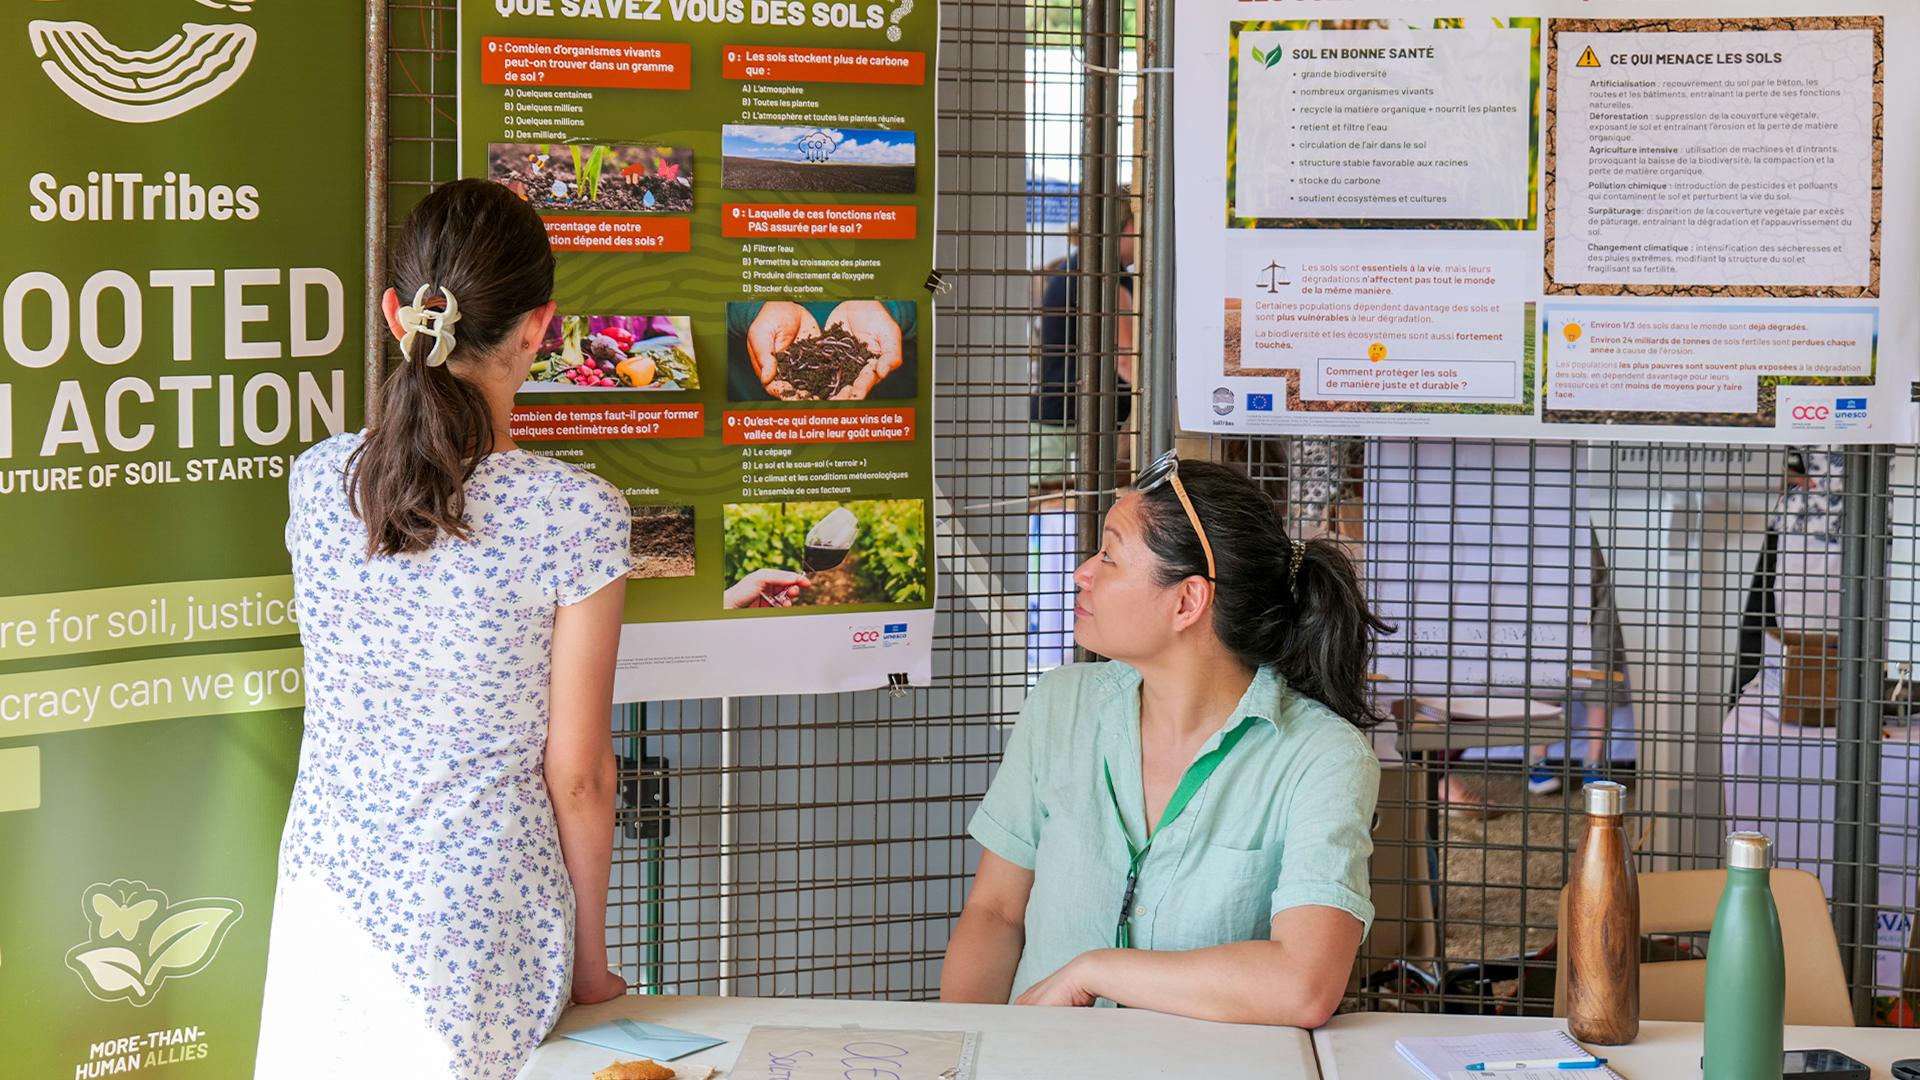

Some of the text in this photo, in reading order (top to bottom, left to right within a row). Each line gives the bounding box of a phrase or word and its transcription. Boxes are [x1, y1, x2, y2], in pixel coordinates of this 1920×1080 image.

[495, 0, 555, 17] QUE
[561, 0, 662, 21] SAVEZ
[669, 0, 744, 23] VOUS
[750, 0, 806, 26] DES
[812, 3, 884, 29] SOLS
[504, 42, 661, 58] Combien d'organismes vivants
[1292, 46, 1434, 59] SOL EN BONNE SANTÉ
[746, 52, 909, 66] Les sols stockent plus de carbone
[1610, 53, 1782, 66] CE QUI MENACE LES SOLS
[505, 58, 547, 68] peut-on
[549, 59, 588, 69] trouver
[589, 60, 614, 70] dans
[632, 63, 674, 73] gramme
[504, 72, 518, 81] de
[520, 72, 536, 81] sol
[1301, 70, 1332, 80] grande
[504, 89, 592, 99] A) Quelques centaines
[1347, 88, 1399, 96] organismes
[1589, 146, 1637, 155] Agriculture
[1628, 182, 1667, 190] chimique
[29, 171, 260, 222] SoilTribes
[1298, 194, 1334, 202] soutient
[748, 208, 791, 220] Laquelle
[792, 209, 805, 218] de
[826, 209, 872, 220] fonctions
[874, 210, 896, 220] n'est
[748, 222, 768, 232] PAS
[770, 223, 809, 232] assurée
[811, 225, 828, 233] par
[829, 223, 838, 232] le
[840, 224, 854, 232] sol
[1588, 243, 1688, 252] Changement climatique
[1326, 367, 1372, 376] Comment
[1421, 369, 1435, 377] les
[1438, 369, 1457, 377] sols
[1326, 380, 1338, 388] de
[1382, 380, 1407, 390] juste
[1422, 382, 1459, 390] durable
[40, 370, 345, 456] ACTION
[554, 412, 568, 421] de
[569, 412, 602, 422] temps
[604, 410, 636, 420] faut-il
[638, 412, 662, 421] pour
[664, 410, 699, 419] former
[792, 416, 807, 426] qui
[809, 416, 839, 425] donne
[860, 415, 879, 424] vins
[881, 415, 892, 424] de
[894, 415, 902, 423] la
[556, 425, 619, 434] centimètres
[620, 424, 634, 434] de
[636, 424, 650, 433] sol
[774, 430, 788, 439] de
[789, 430, 798, 438] la
[800, 429, 825, 438] Loire
[827, 429, 846, 438] leur
[871, 428, 902, 438] unique
[88, 463, 120, 488] OF
[125, 459, 180, 485] SOIL
[186, 455, 285, 482] STARTS
[47, 608, 99, 644] for
[107, 598, 177, 638] soil,
[183, 591, 299, 640] justice
[0, 665, 305, 722] cracy can we gro
[89, 1025, 206, 1059] MORE-THAN-
[75, 1043, 208, 1080] HUMAN ALLIES
